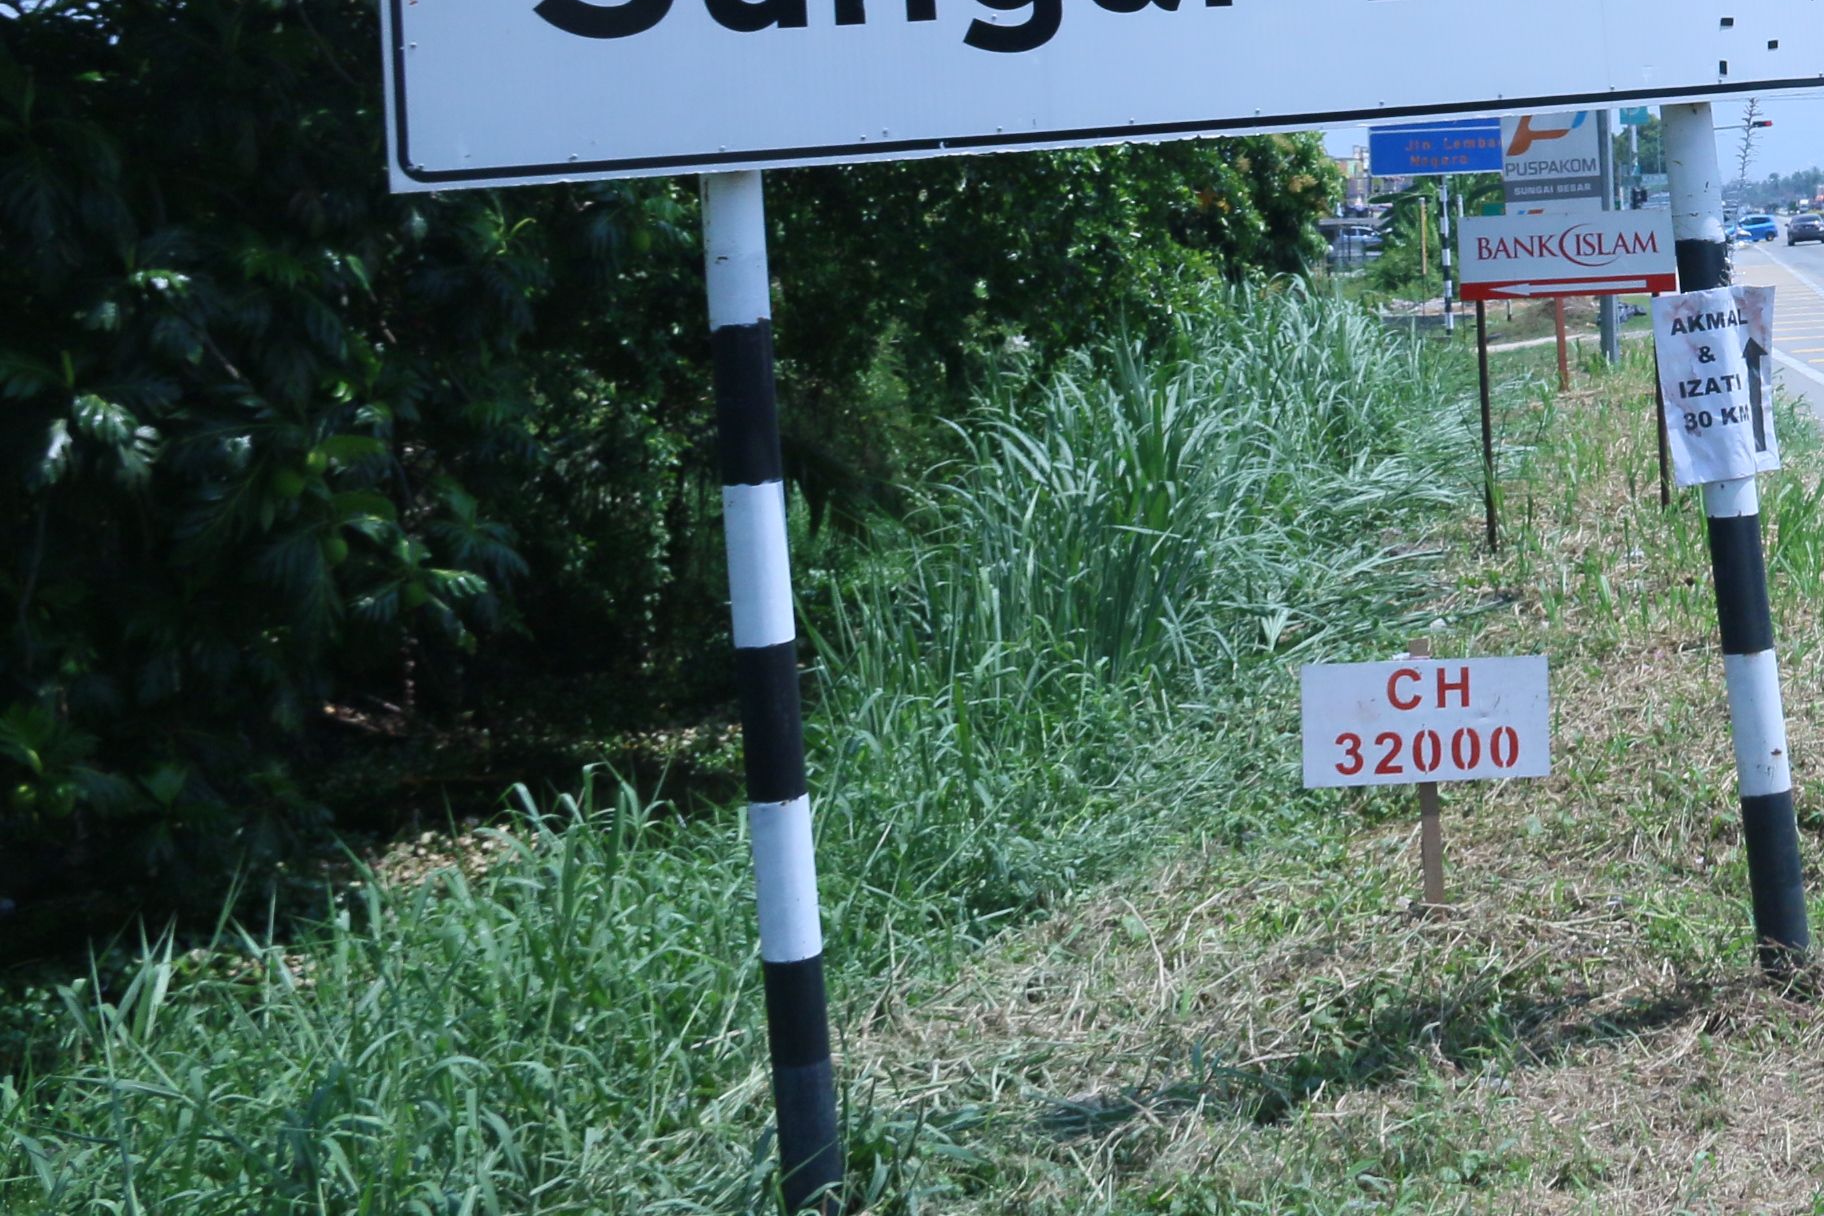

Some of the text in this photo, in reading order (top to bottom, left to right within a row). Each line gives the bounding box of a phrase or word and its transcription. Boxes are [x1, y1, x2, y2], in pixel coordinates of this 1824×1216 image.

[1505, 158, 1597, 176] PUSPAKOM
[1513, 183, 1592, 196] SUNGAI BESAR
[1476, 230, 1659, 261] BANK ISLAM
[1671, 308, 1749, 336] AKMAL
[1698, 346, 1716, 364] &
[1679, 374, 1742, 399] IZATI
[1684, 404, 1750, 431] 30 KM
[1387, 666, 1470, 711] CH
[1334, 726, 1520, 776] 32000
